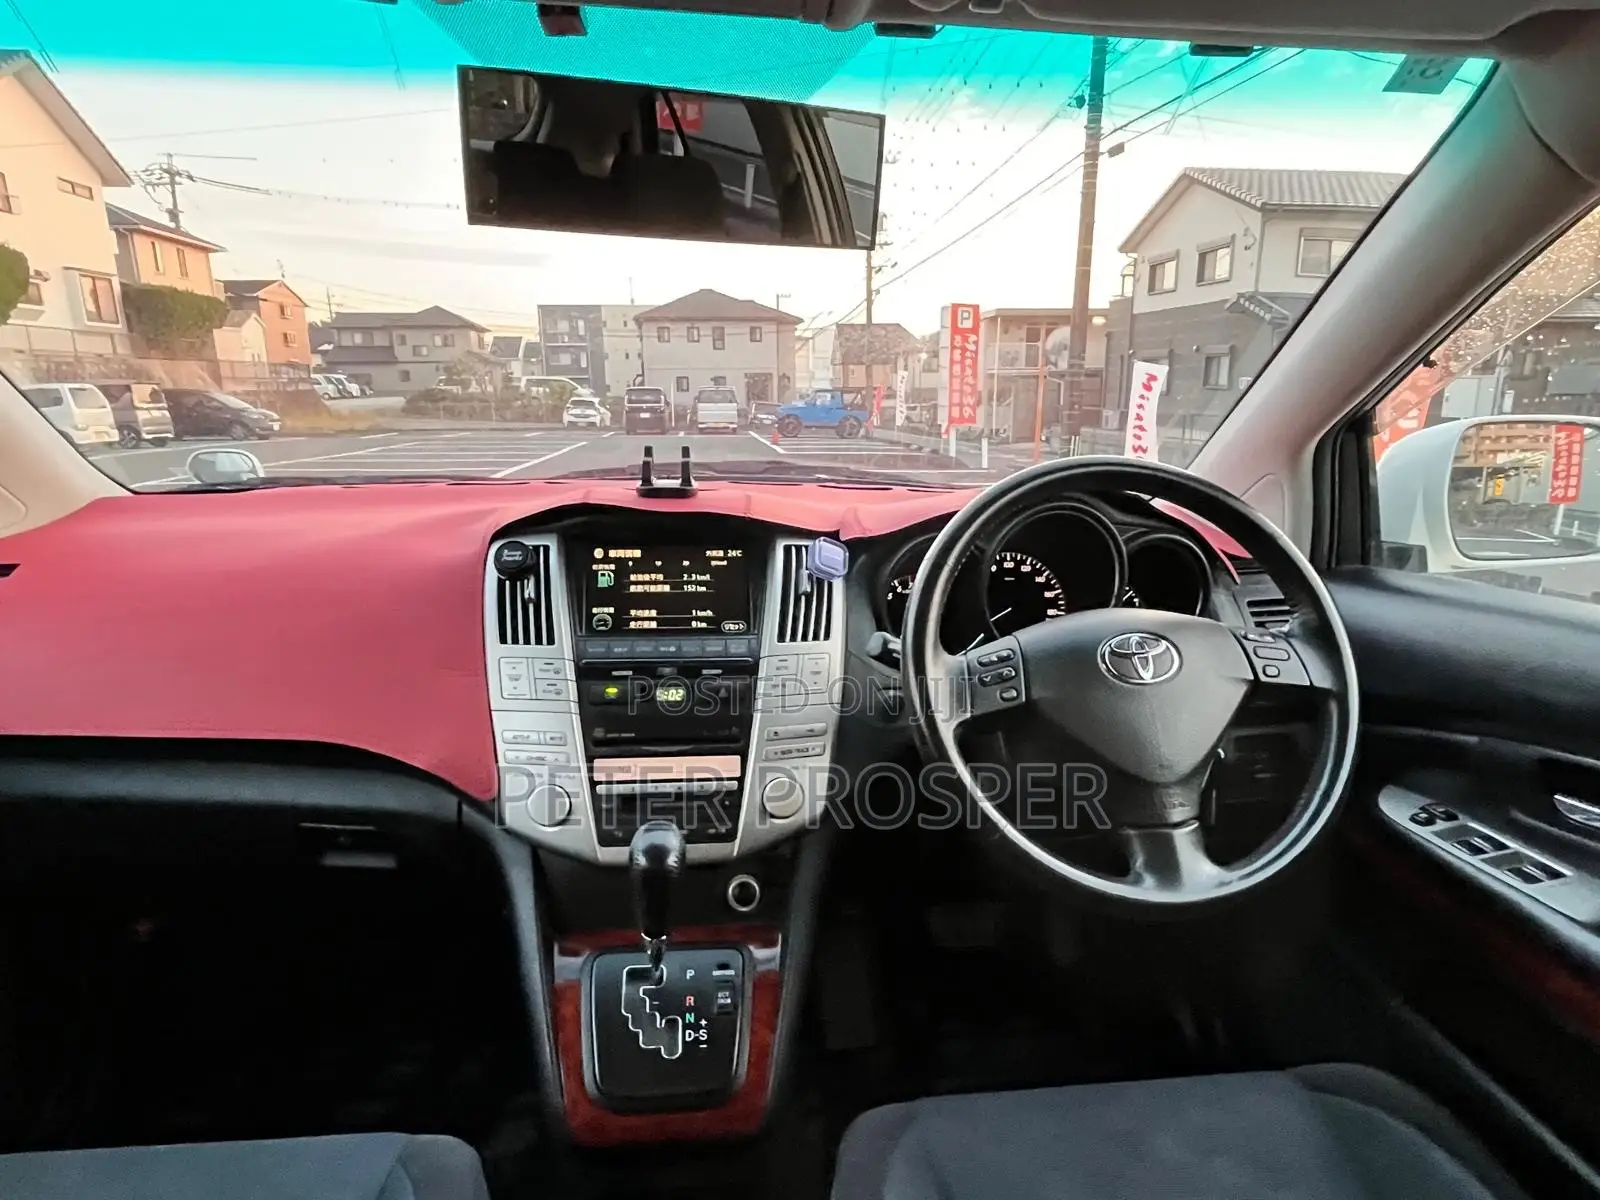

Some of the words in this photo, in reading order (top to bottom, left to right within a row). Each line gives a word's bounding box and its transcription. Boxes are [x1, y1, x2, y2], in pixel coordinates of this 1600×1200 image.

[960, 310, 971, 326] P
[686, 969, 695, 980] P
[685, 995, 695, 1006] R
[685, 1012, 695, 1023] N
